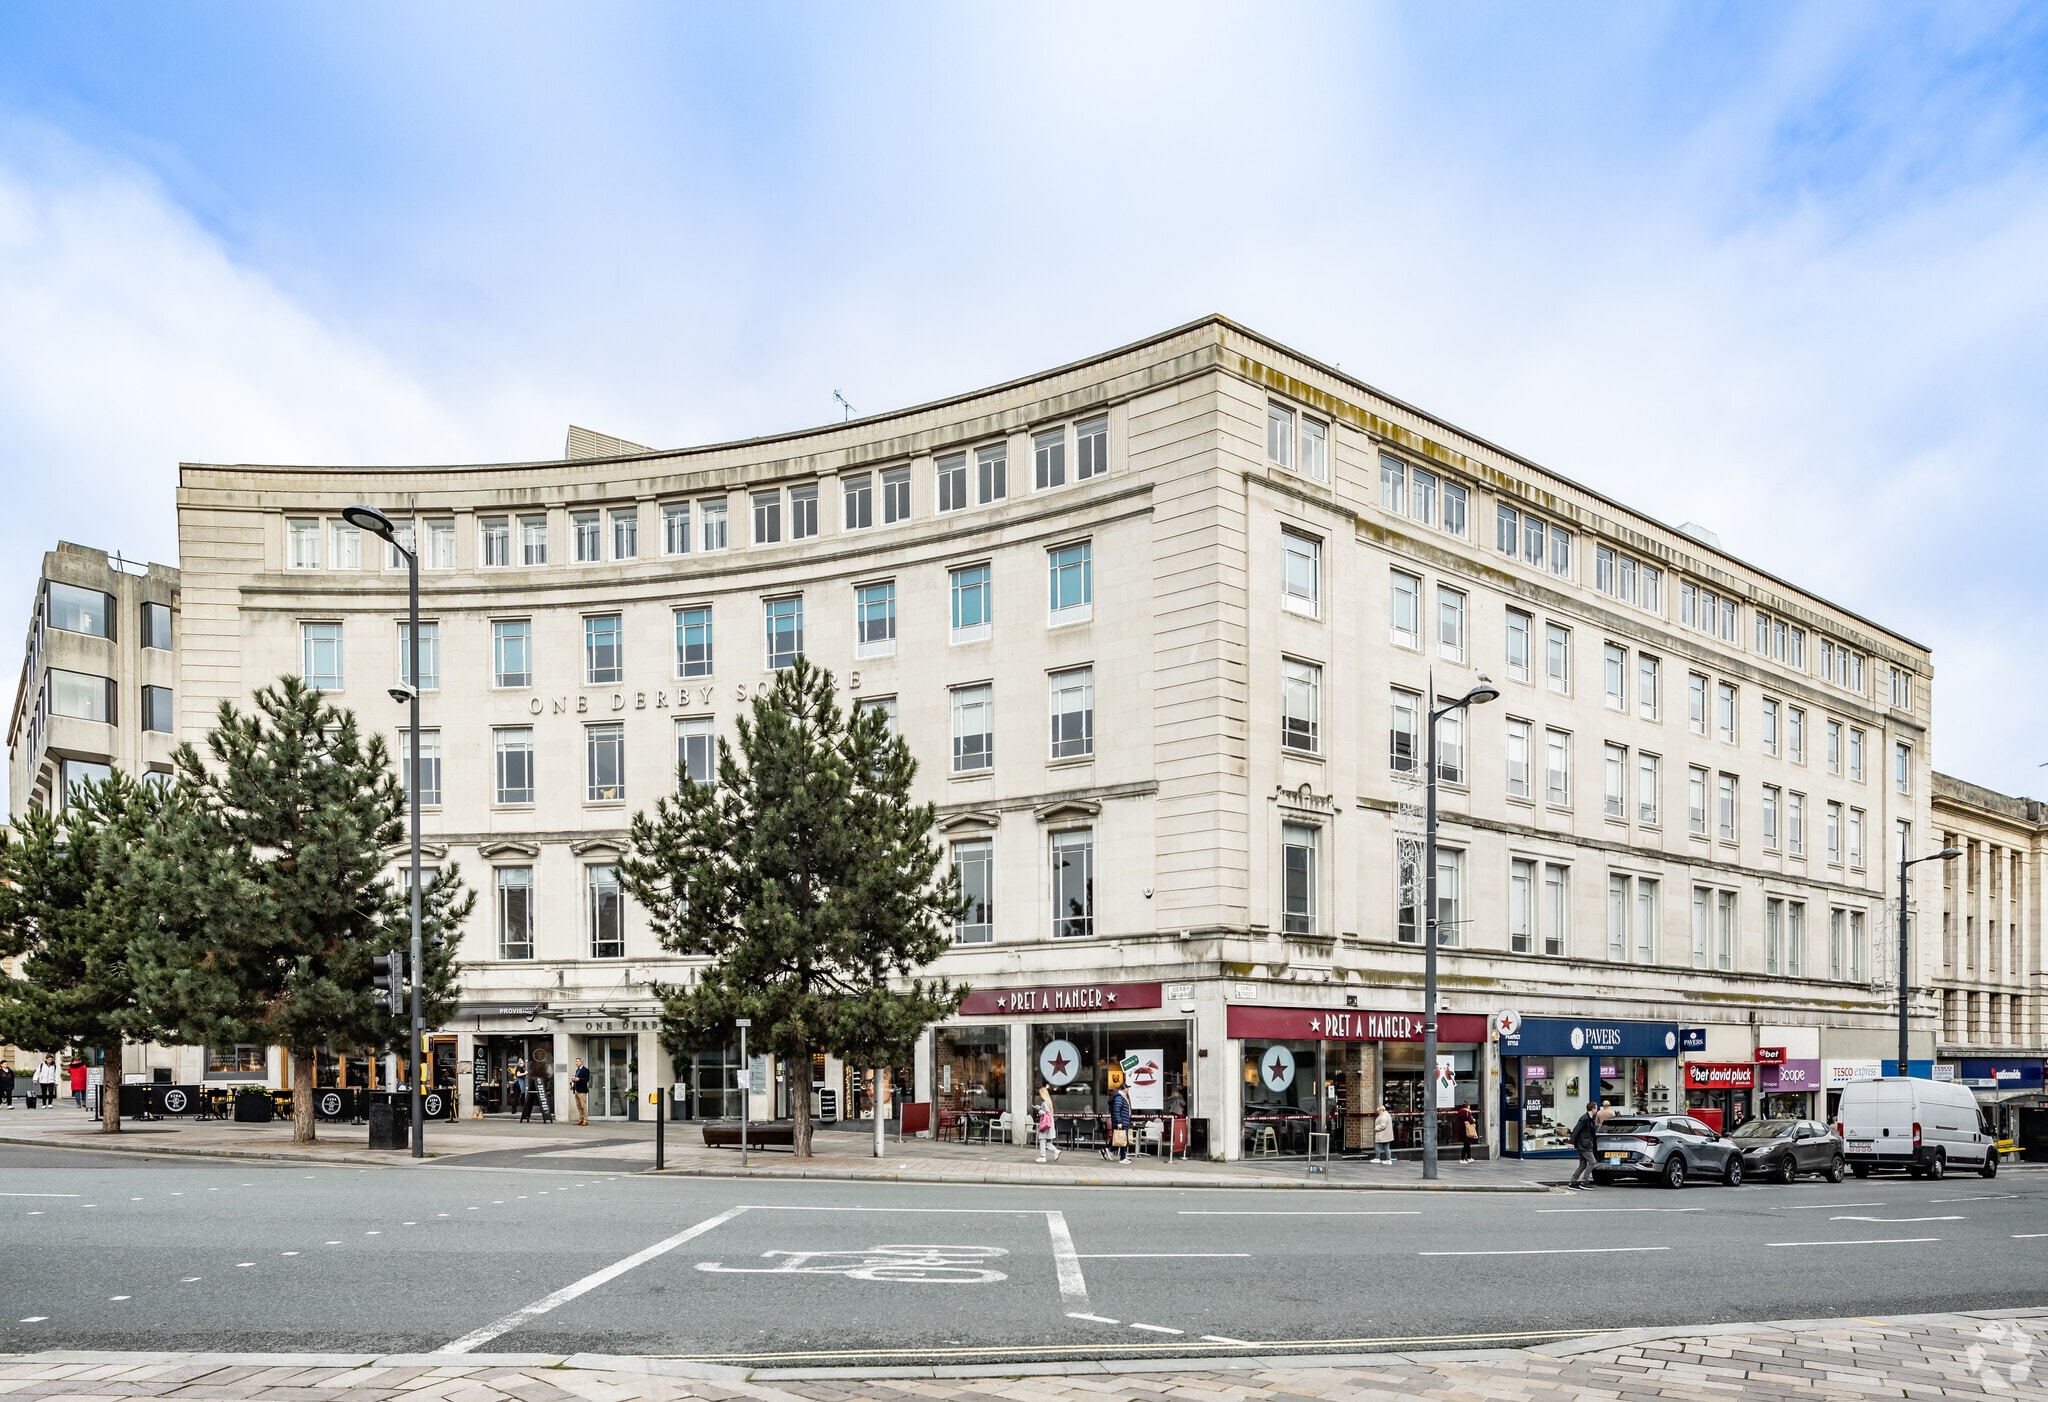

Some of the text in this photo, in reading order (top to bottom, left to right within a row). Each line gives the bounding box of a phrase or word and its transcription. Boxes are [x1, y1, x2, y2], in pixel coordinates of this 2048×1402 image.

[529, 671, 861, 714] ONE DERBY SQRE
[1011, 989, 1102, 1010] PRET A MANGER
[586, 1021, 658, 1030] ONE DERB
[1325, 1013, 1411, 1038] PRET A MANGER
[1585, 1028, 1620, 1045] PAVERS
[1710, 1068, 1731, 1081] david
[1731, 1068, 1751, 1084] pluck
[1833, 1067, 1877, 1078] TESCO express
